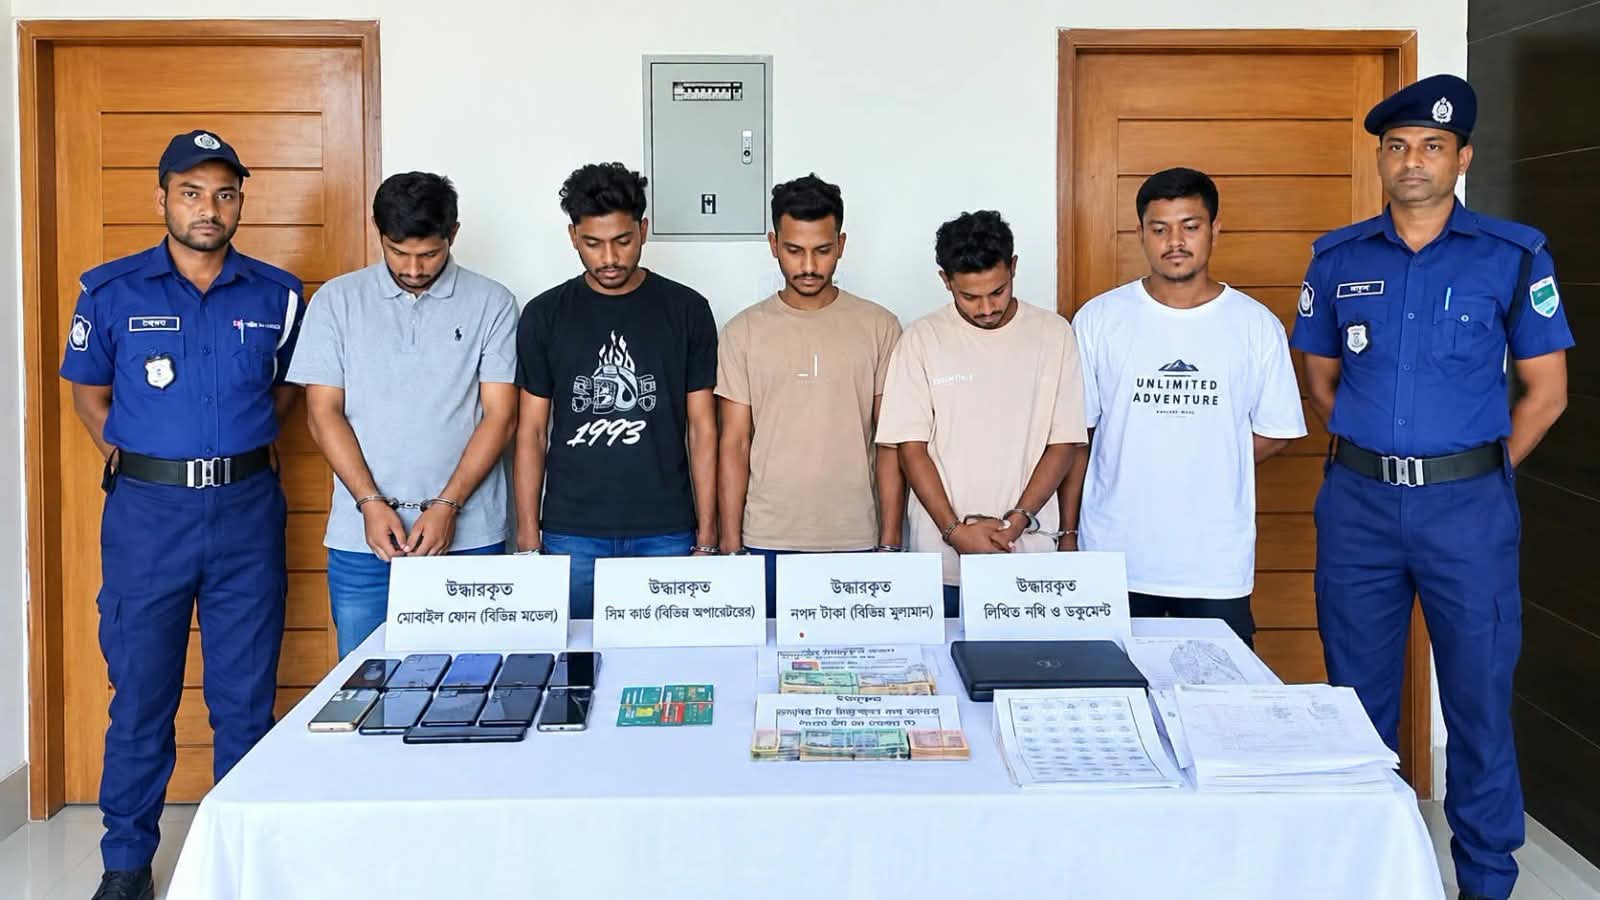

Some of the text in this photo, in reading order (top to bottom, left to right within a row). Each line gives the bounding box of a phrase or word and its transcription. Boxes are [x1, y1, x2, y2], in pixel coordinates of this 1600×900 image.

[1136, 378, 1217, 390] UNLIMITED
[1132, 392, 1219, 405] ADVENTURE
[566, 419, 647, 447] 1993
[445, 579, 514, 601] উদ্ধারকৃত
[648, 577, 712, 598] উদ্ধারকৃত
[830, 577, 892, 598] উদ্ধারকৃত
[1016, 576, 1077, 597] উদ্ধারকৃত
[397, 608, 444, 625] মোবাইল
[448, 610, 476, 624] ফোন
[480, 607, 517, 625] (বিভিন্ন
[605, 605, 625, 621] সিম
[629, 604, 651, 620] কার্ড
[654, 603, 689, 621] (বিভিন্ন
[820, 604, 846, 620] টাকা
[850, 603, 886, 621] (বিভিন্ন
[1050, 606, 1061, 618] ও
[1063, 601, 1112, 621] ডকুমেন্ট
